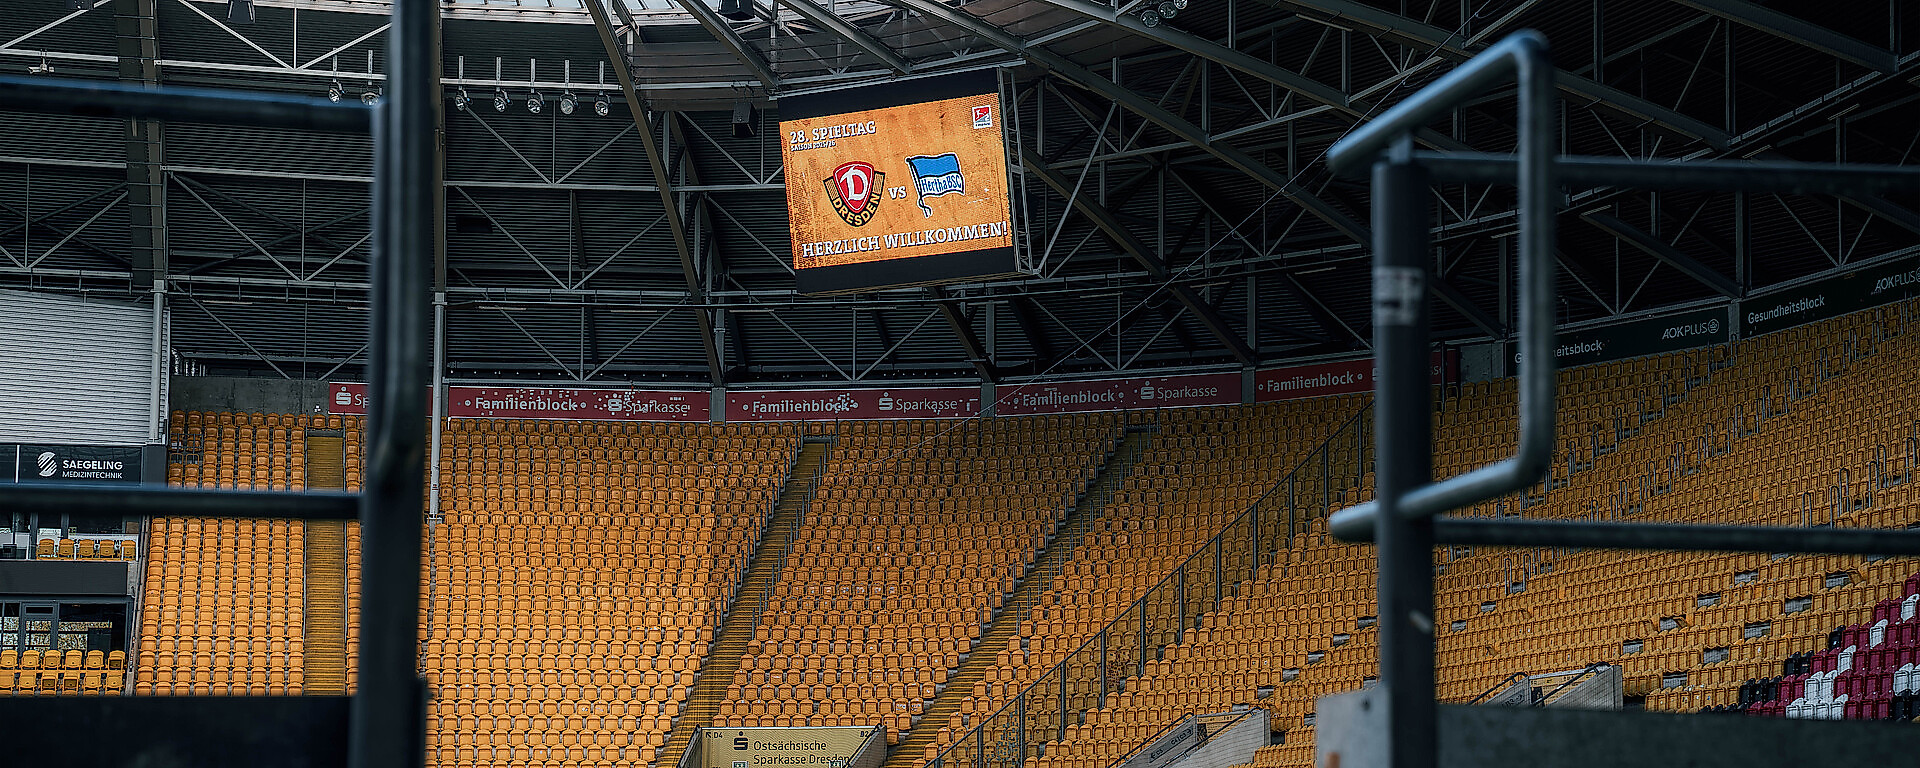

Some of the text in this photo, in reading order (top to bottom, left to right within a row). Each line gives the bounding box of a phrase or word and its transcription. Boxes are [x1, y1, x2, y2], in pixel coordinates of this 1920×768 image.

[790, 121, 876, 144] 28. SPIELTAG
[791, 143, 813, 152] SAISON
[840, 166, 868, 200] D
[833, 193, 880, 227] DRESDEN
[802, 221, 1008, 258] HERZLICH WILLKOMMEN!
[1748, 294, 1825, 324] Gesundheitsblock
[1266, 371, 1354, 392] Familienblock
[1022, 383, 1218, 406] Familienblock Sparkasse
[475, 396, 689, 416] Familienblock Sparkasse
[752, 398, 958, 413] Familienblock Sparkasse
[62, 459, 123, 470] SAEGELING
[62, 471, 123, 479] MEDIZINTECHNIK
[753, 740, 827, 751] Ostsächsische
[753, 754, 806, 766] Sparkasse
